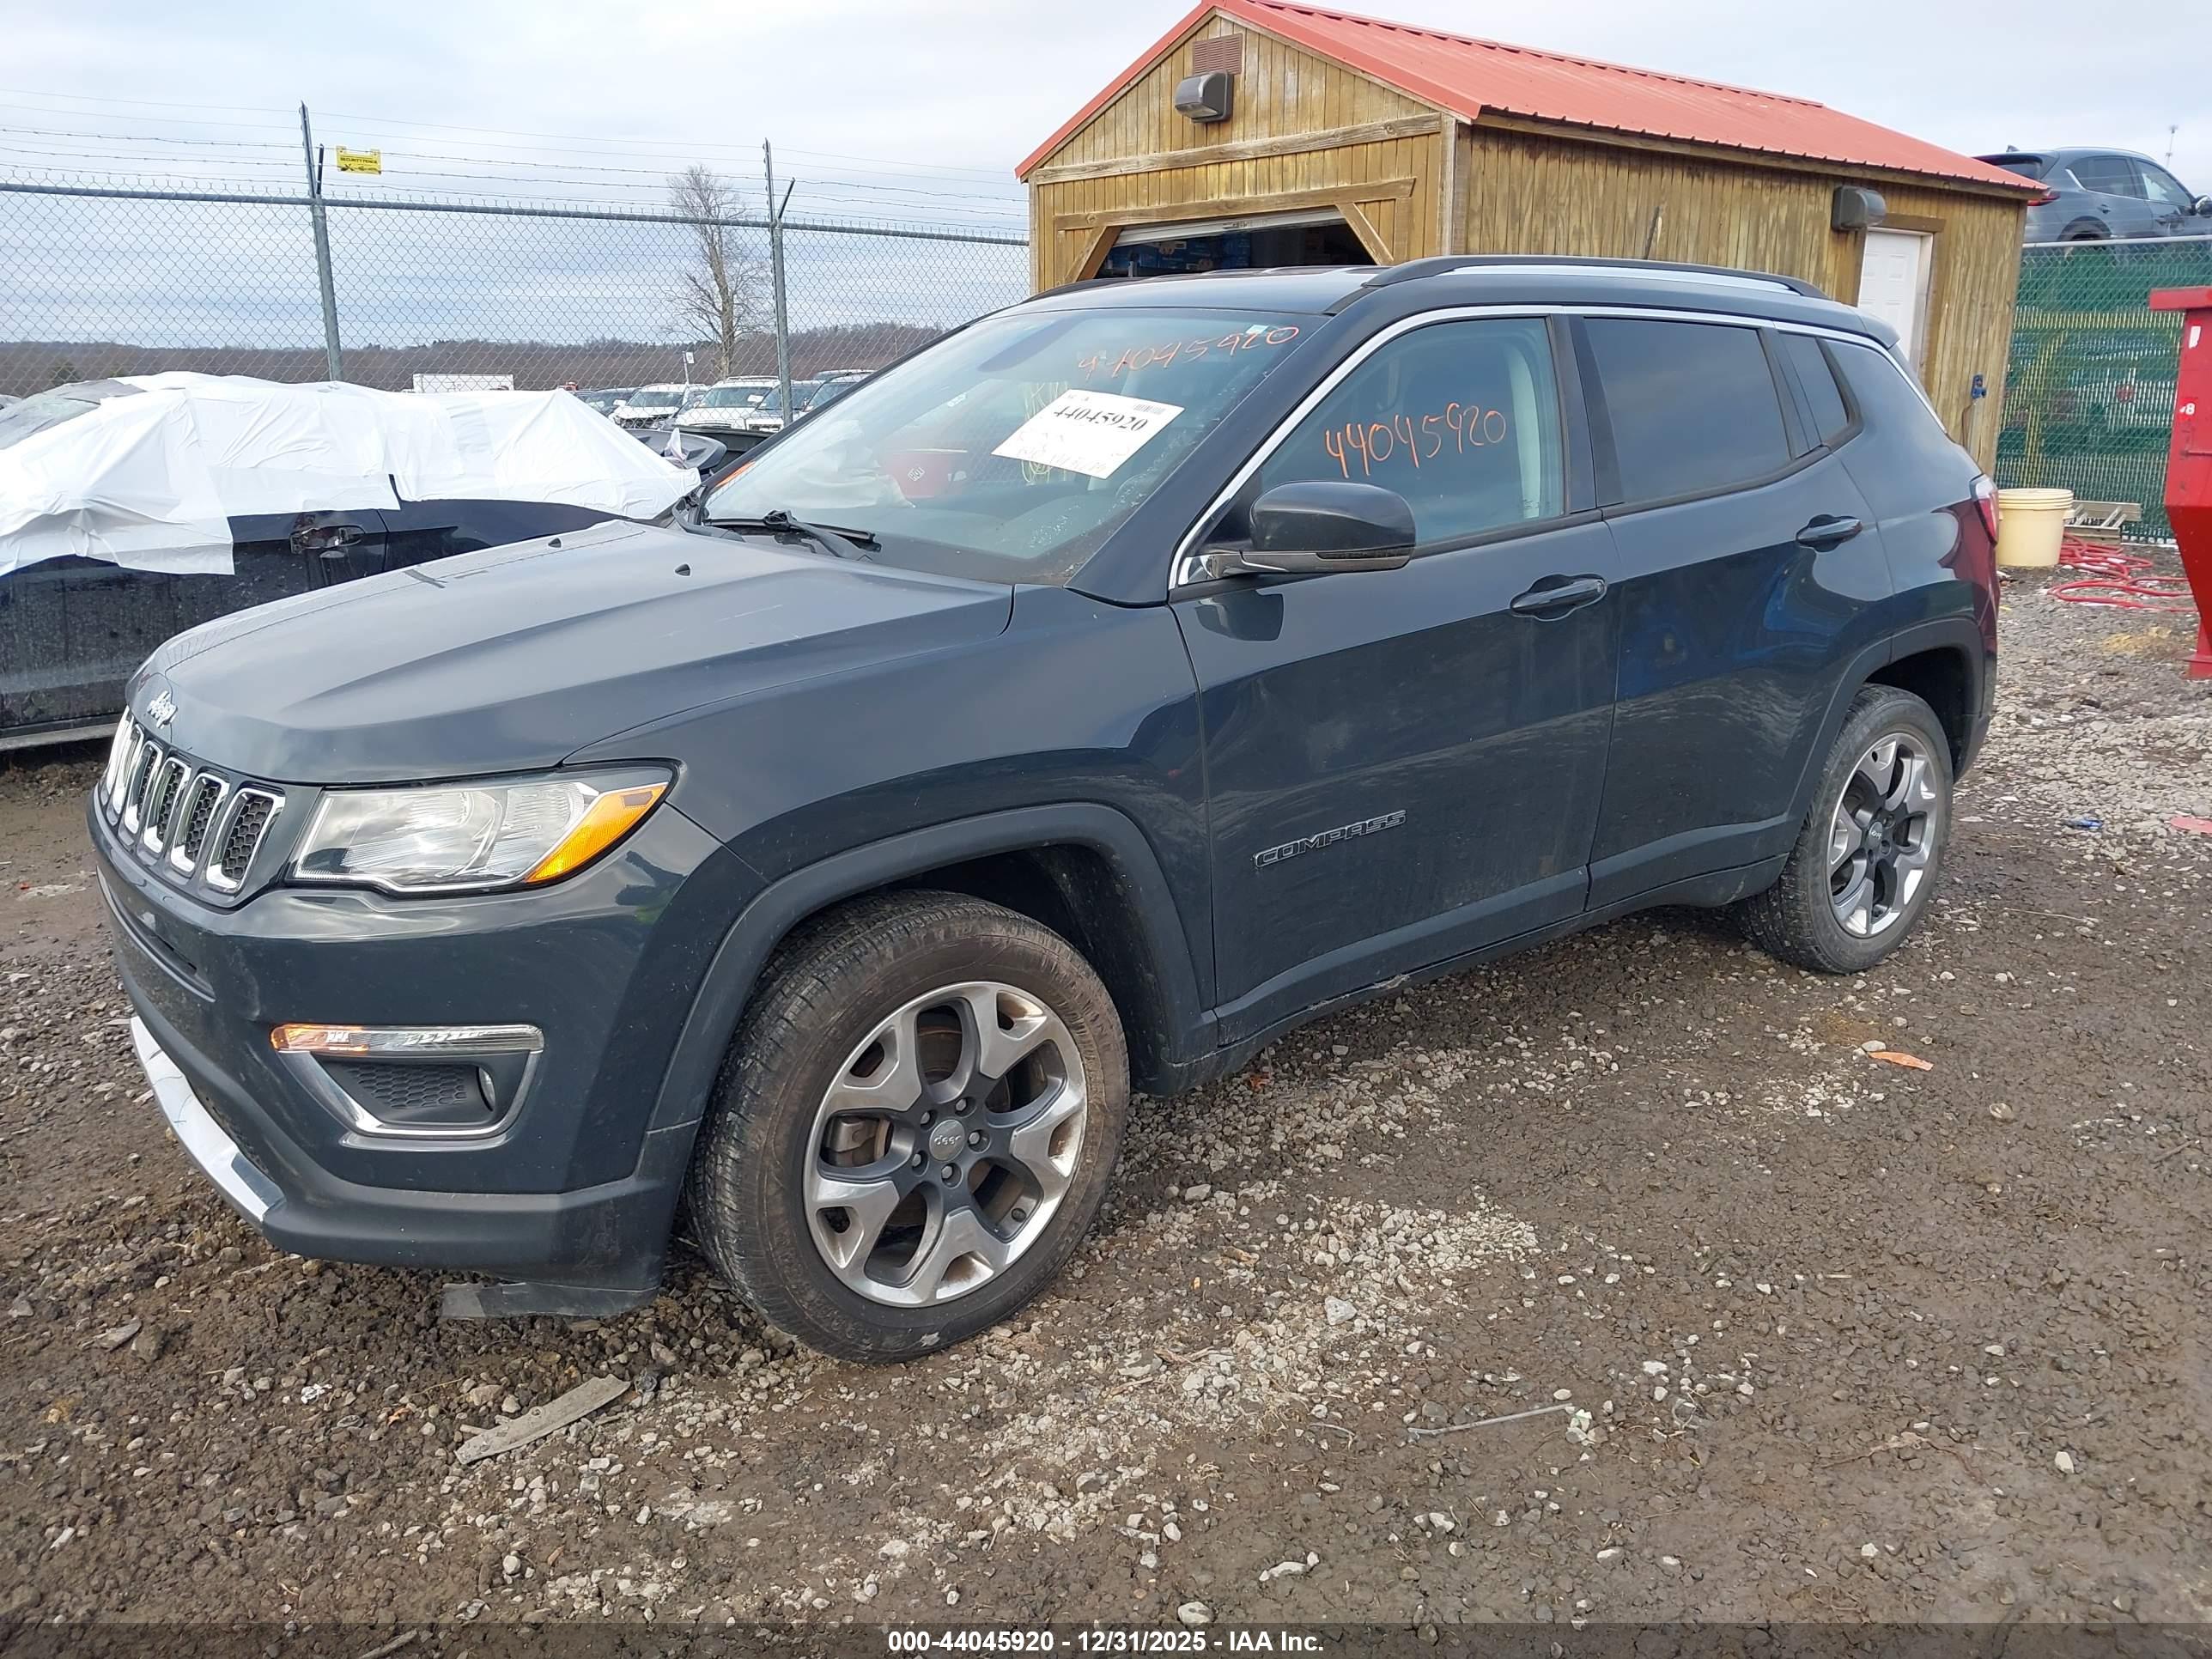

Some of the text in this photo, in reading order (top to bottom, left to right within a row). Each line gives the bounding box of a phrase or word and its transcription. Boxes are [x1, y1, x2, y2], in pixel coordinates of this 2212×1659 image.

[1054, 405, 1148, 431] 44045920
[1325, 402, 1506, 478] 44045920
[1255, 810, 1407, 868] COMPASS
